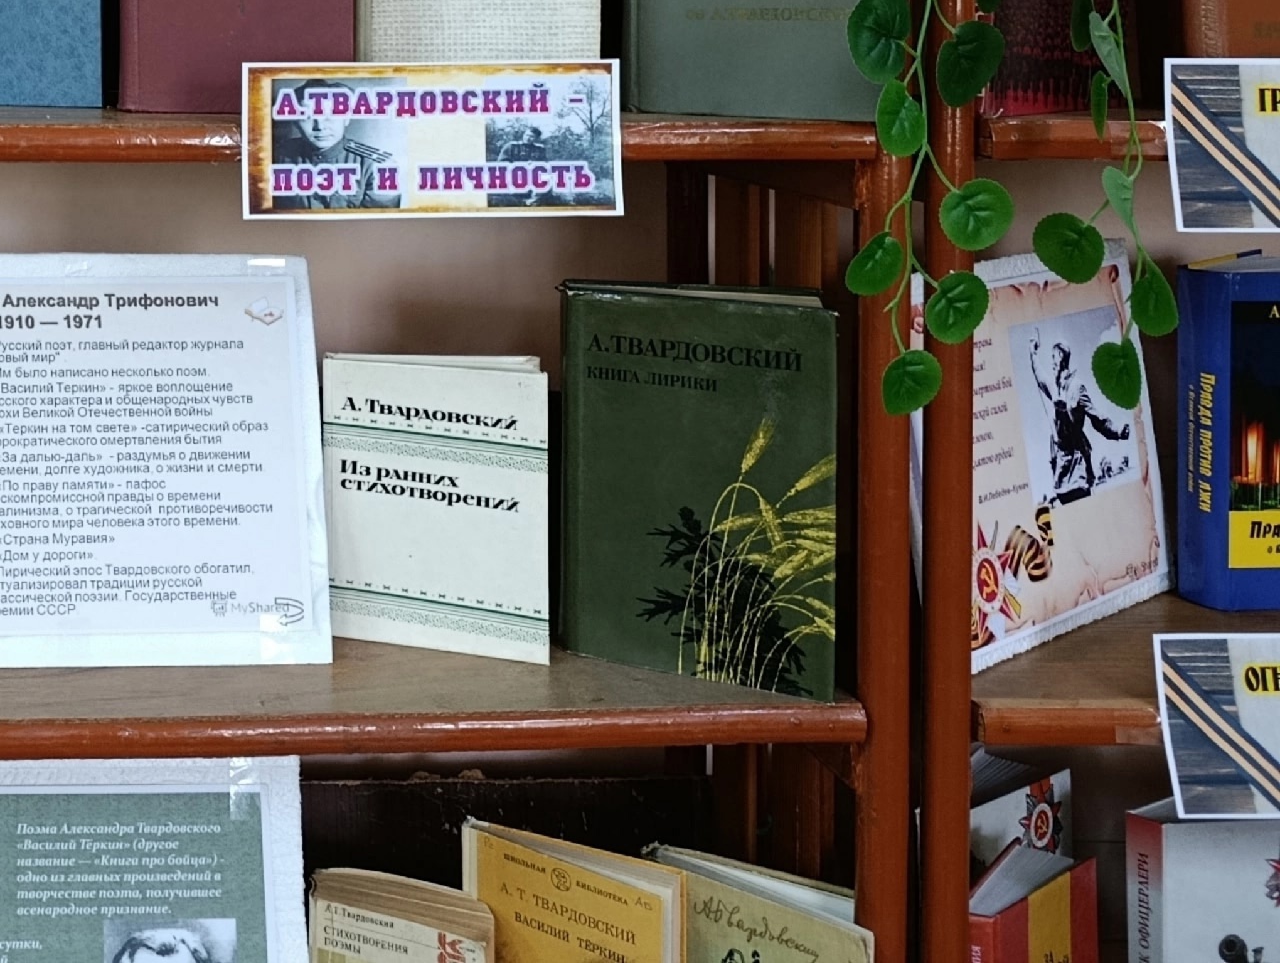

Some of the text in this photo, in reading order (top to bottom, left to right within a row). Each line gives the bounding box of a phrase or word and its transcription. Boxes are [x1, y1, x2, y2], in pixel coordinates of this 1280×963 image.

[276, 83, 550, 118] А.ТВАРДОВСКИЙ
[273, 164, 593, 194] ПОЭТ И ЛИЧНОСТЬ
[2, 294, 100, 310] Александр
[104, 293, 218, 310] Трифонович
[64, 314, 102, 328] 1971
[78, 339, 129, 350] главный
[132, 341, 188, 352] редактор
[191, 340, 244, 352] журнала
[587, 334, 803, 373] А.ТВАРДОВСКИЙ
[587, 366, 718, 393] КНИГА ЛИРИКИ
[341, 396, 519, 431] А. Твардовский
[340, 460, 460, 491] Из ранних
[340, 478, 520, 514] стихотворений
[16, 824, 56, 834] Поэма
[17, 839, 76, 850] «Василий
[133, 838, 179, 852] (другое
[17, 858, 75, 866] название
[94, 855, 138, 865] «Книга
[142, 858, 164, 868] про
[168, 854, 217, 867] бойца»)
[17, 871, 48, 882] одно
[51, 874, 64, 882] из
[68, 874, 120, 882] главных
[504, 853, 628, 906] ШКОЛЬНАЯ БИБЛИОТЕКА
[515, 912, 570, 943] ВАСИЛИЙ
[533, 894, 636, 945] ТВАРДОВСКИЙ
[324, 926, 409, 955] СТИХОТВОРЕНИЯ
[324, 937, 361, 955] ПОЭМЫ
